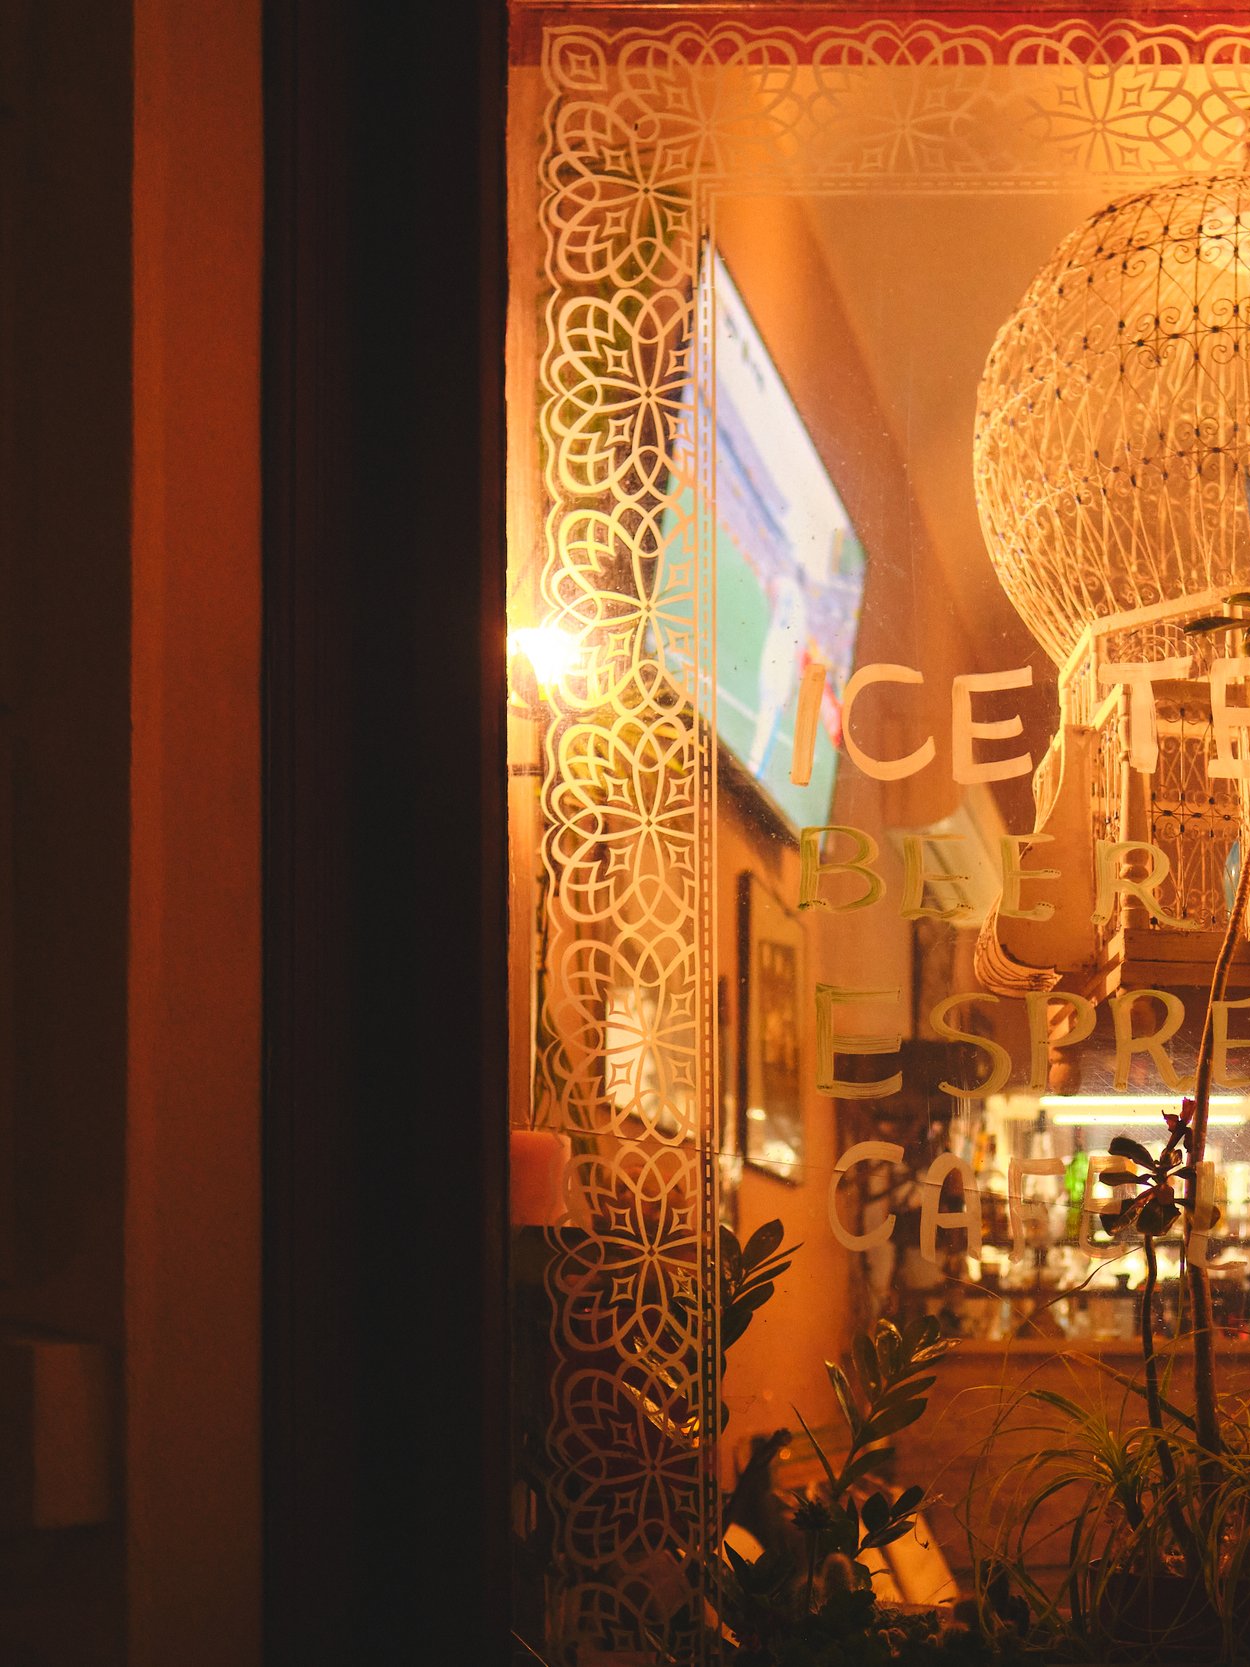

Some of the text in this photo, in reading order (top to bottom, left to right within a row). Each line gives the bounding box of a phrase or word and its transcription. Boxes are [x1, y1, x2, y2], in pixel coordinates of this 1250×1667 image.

[791, 663, 1033, 786] ICE
[798, 825, 1204, 929] BEER
[829, 1140, 1138, 1265] CAFE
